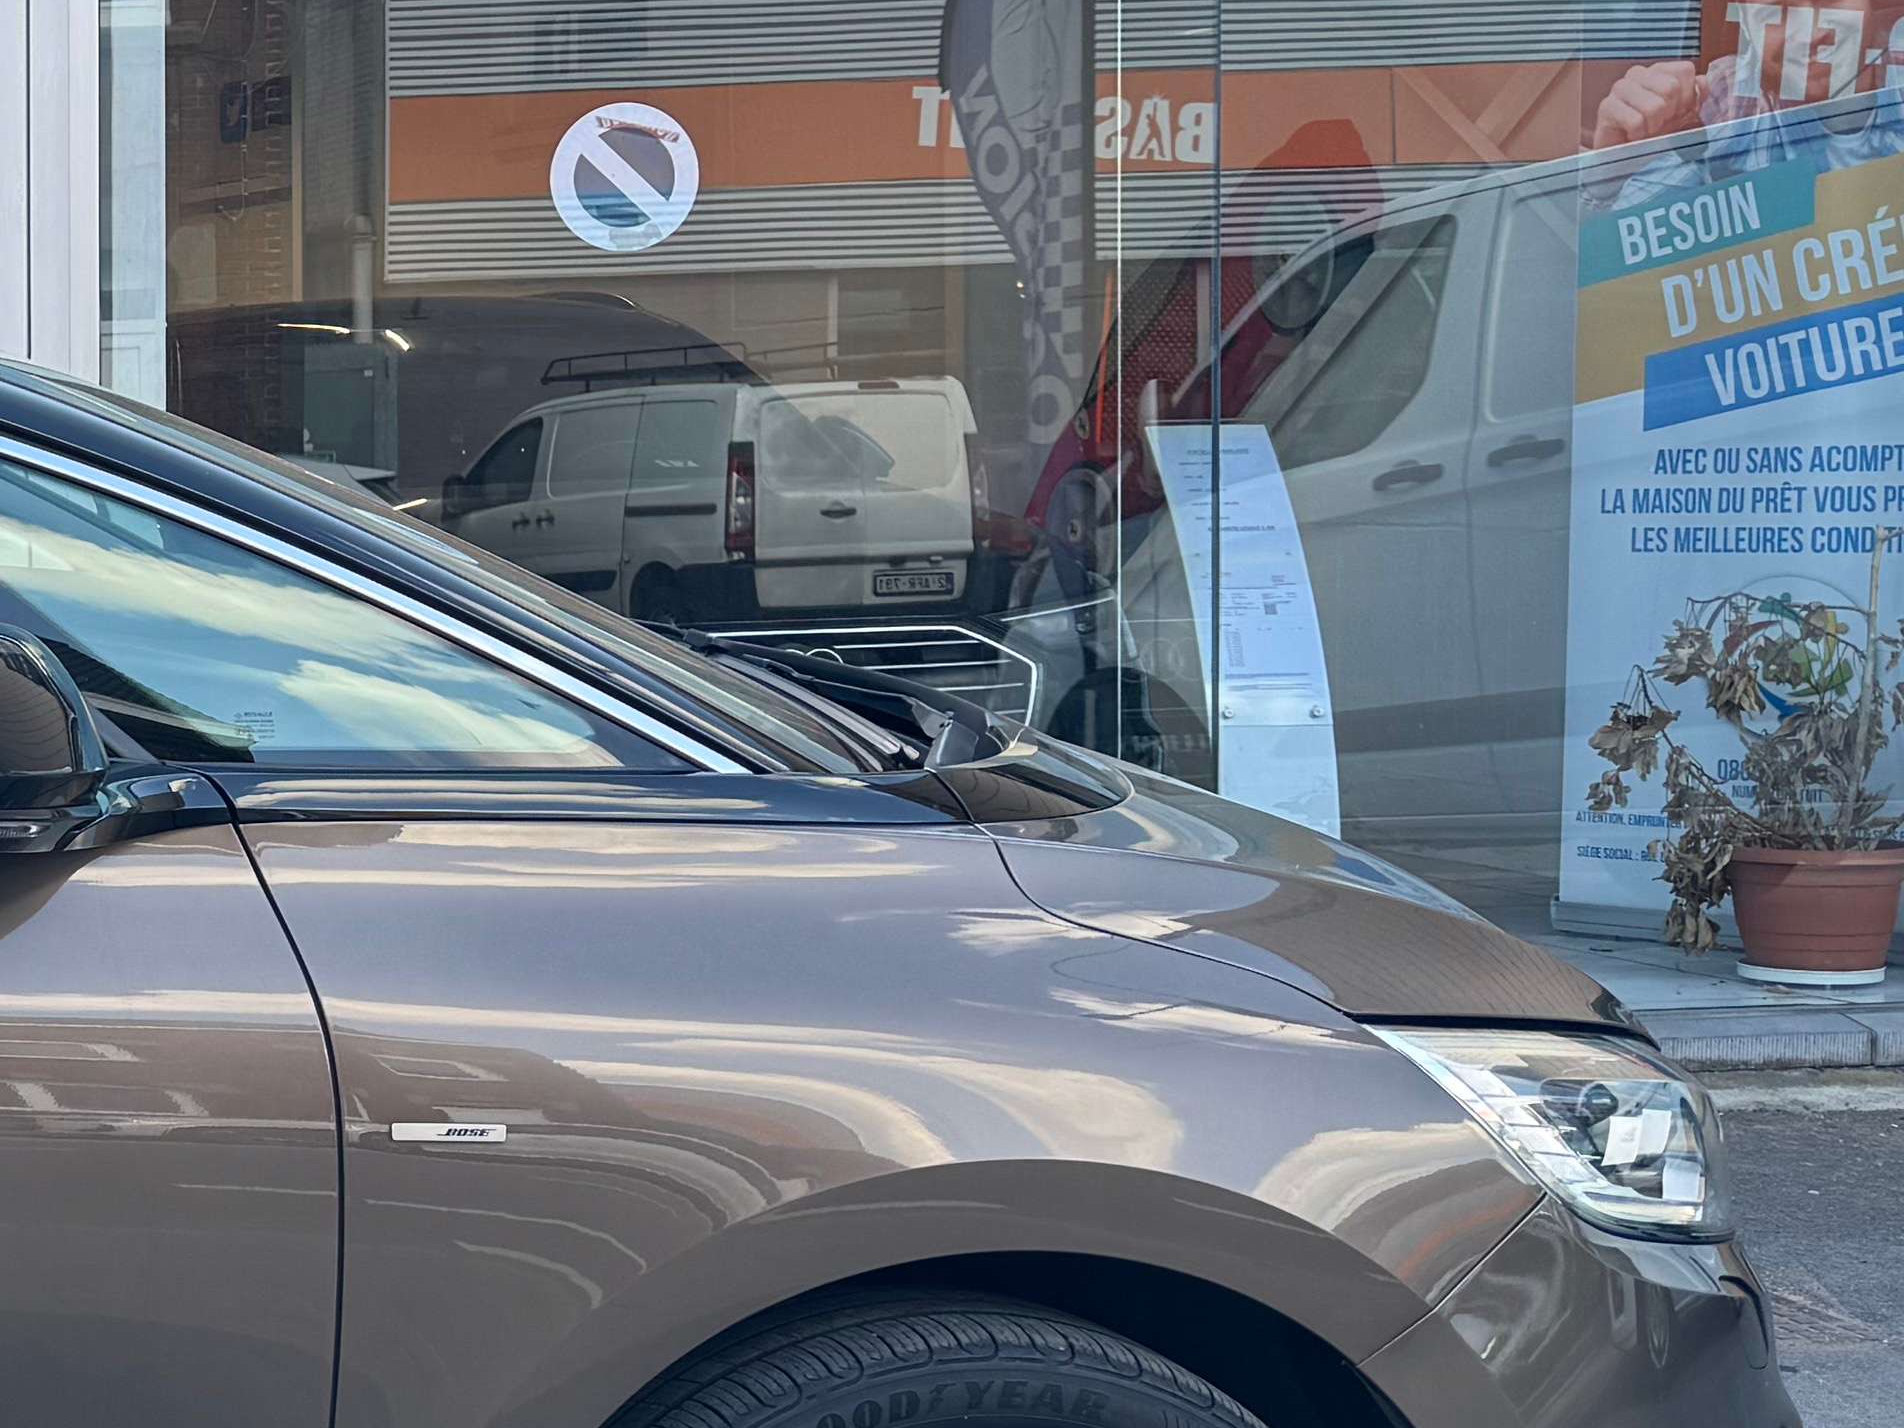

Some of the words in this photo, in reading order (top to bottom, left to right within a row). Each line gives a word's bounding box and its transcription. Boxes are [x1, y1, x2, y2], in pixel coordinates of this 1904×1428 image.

[1617, 181, 1761, 266] BESOIN
[1792, 204, 1904, 303] CRÉ
[1654, 447, 1707, 475] AVEC
[1713, 447, 1741, 475] OU
[1746, 445, 1803, 474] SANS
[1600, 487, 1626, 514] LA
[1632, 487, 1712, 514] MAISON
[1717, 486, 1744, 514] DU
[1752, 481, 1807, 514] PRÊT
[1814, 485, 1876, 513] VOUS
[1631, 526, 1668, 553] LES
[1674, 526, 1803, 554] MEILLEURES
[437, 1128, 497, 1137] BOSE
